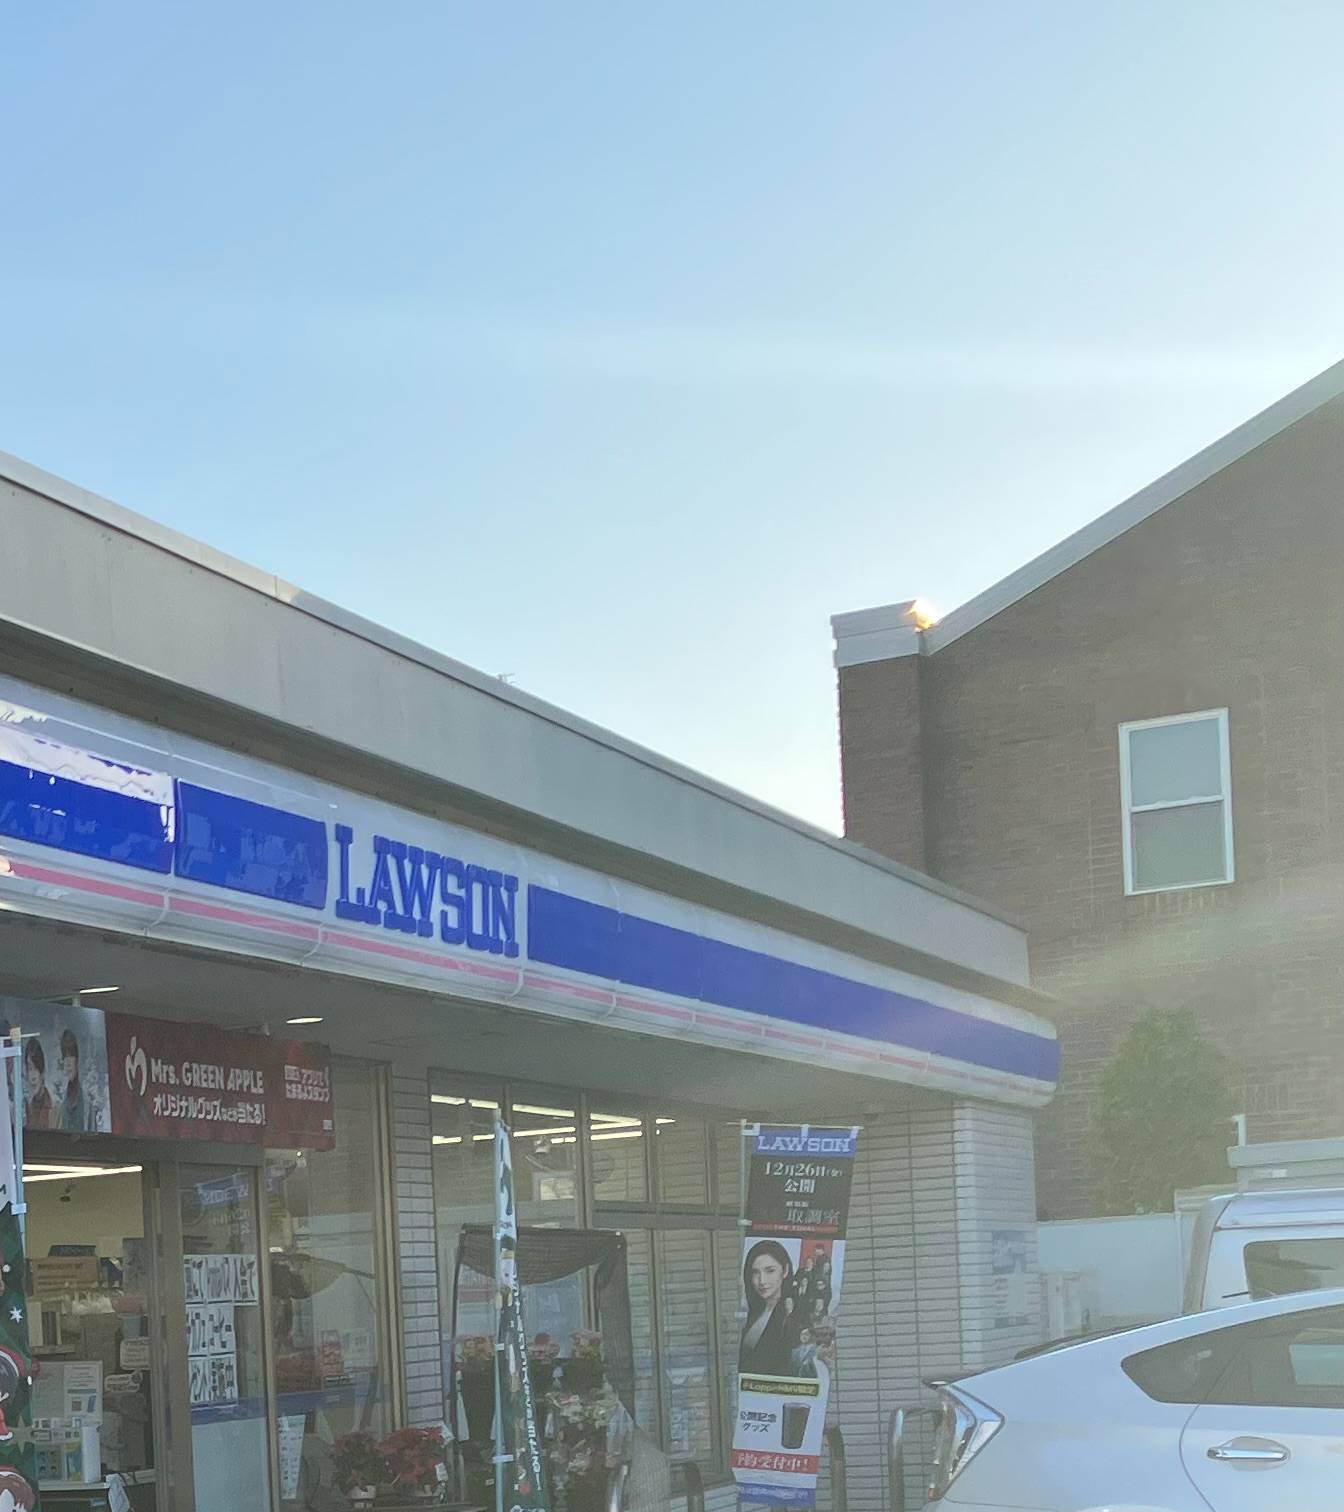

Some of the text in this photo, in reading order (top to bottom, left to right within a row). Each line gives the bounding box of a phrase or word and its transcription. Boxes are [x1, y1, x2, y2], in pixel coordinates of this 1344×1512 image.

[335, 823, 519, 959] LAWSON
[150, 1057, 180, 1085] Mrs.
[182, 1062, 225, 1090] GREEN
[227, 1068, 265, 1094] APPLE
[757, 1135, 850, 1153] LAWSON
[784, 1178, 816, 1194] 公開
